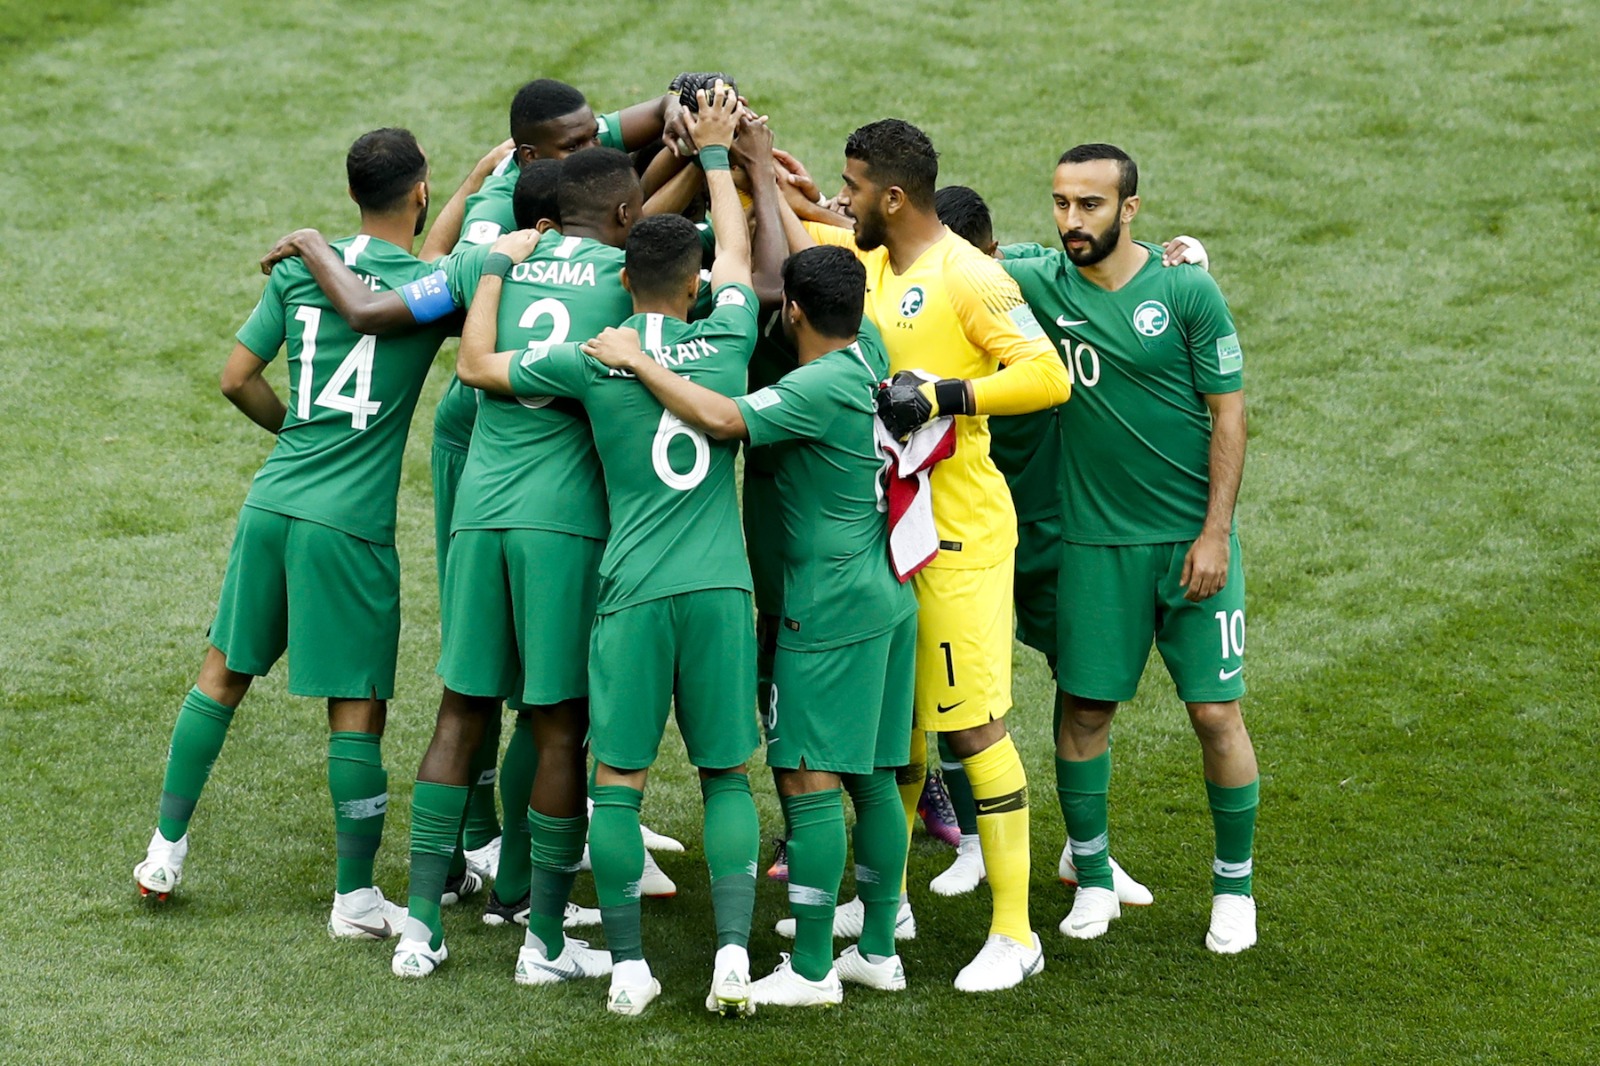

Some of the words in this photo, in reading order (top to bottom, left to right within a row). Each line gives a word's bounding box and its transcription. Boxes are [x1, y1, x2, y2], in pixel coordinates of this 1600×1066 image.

[512, 261, 596, 287] OSAMA
[896, 321, 914, 330] KSA
[295, 305, 382, 430] 14
[1060, 339, 1101, 387] 10
[651, 375, 711, 491] 6
[1215, 609, 1245, 659] 10
[940, 642, 955, 687] 1
